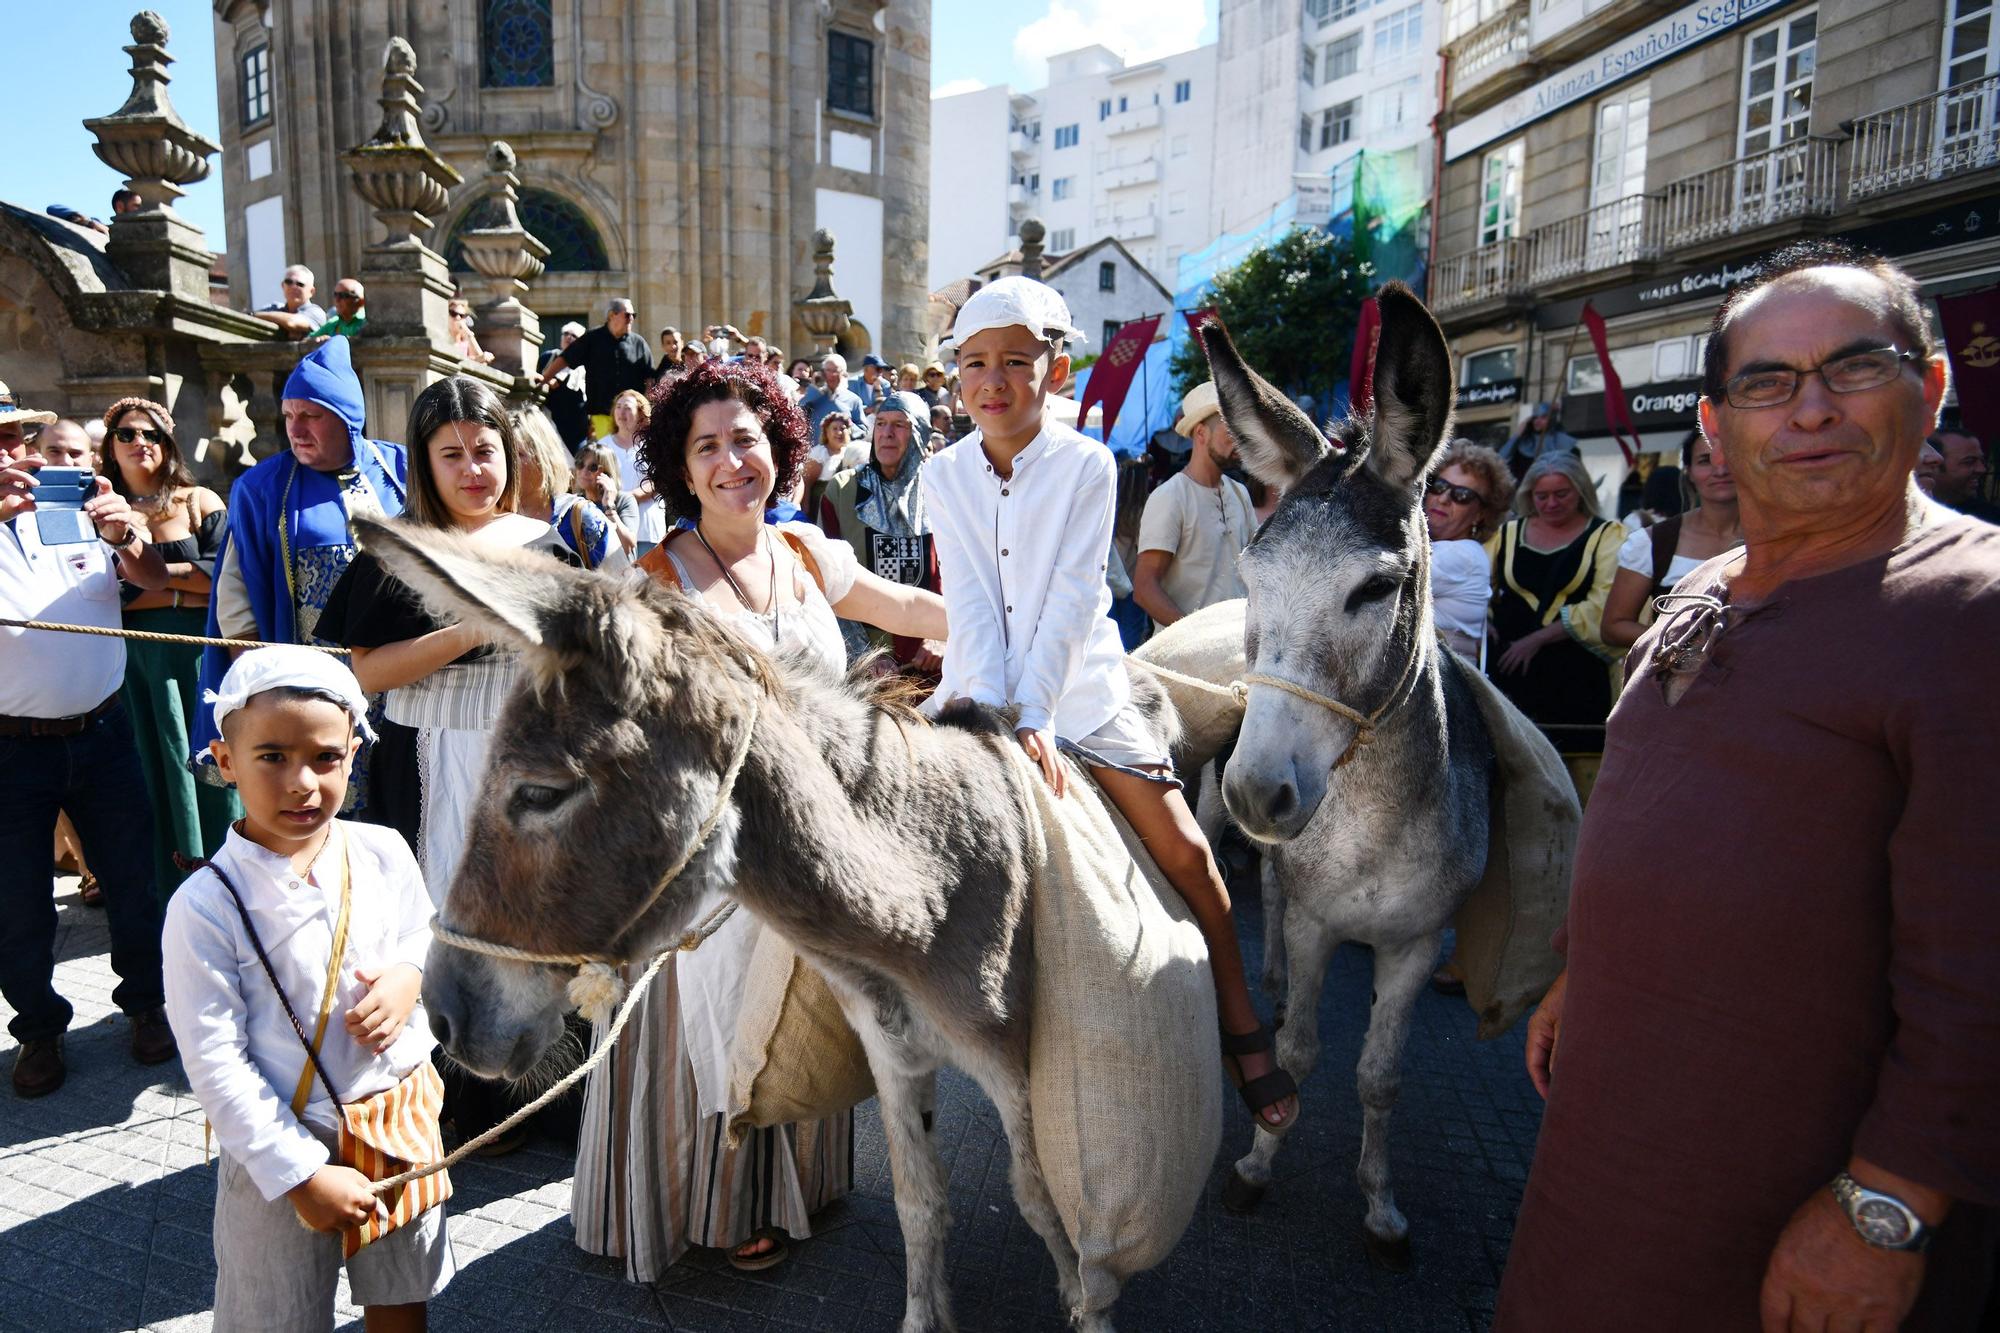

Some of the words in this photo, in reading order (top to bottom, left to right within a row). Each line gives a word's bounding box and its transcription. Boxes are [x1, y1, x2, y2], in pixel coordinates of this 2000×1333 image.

[1532, 69, 1595, 113] Alianza
[1602, 21, 1688, 78] Española
[1639, 284, 1679, 300] VIAJES
[1632, 392, 1697, 413] Orange
